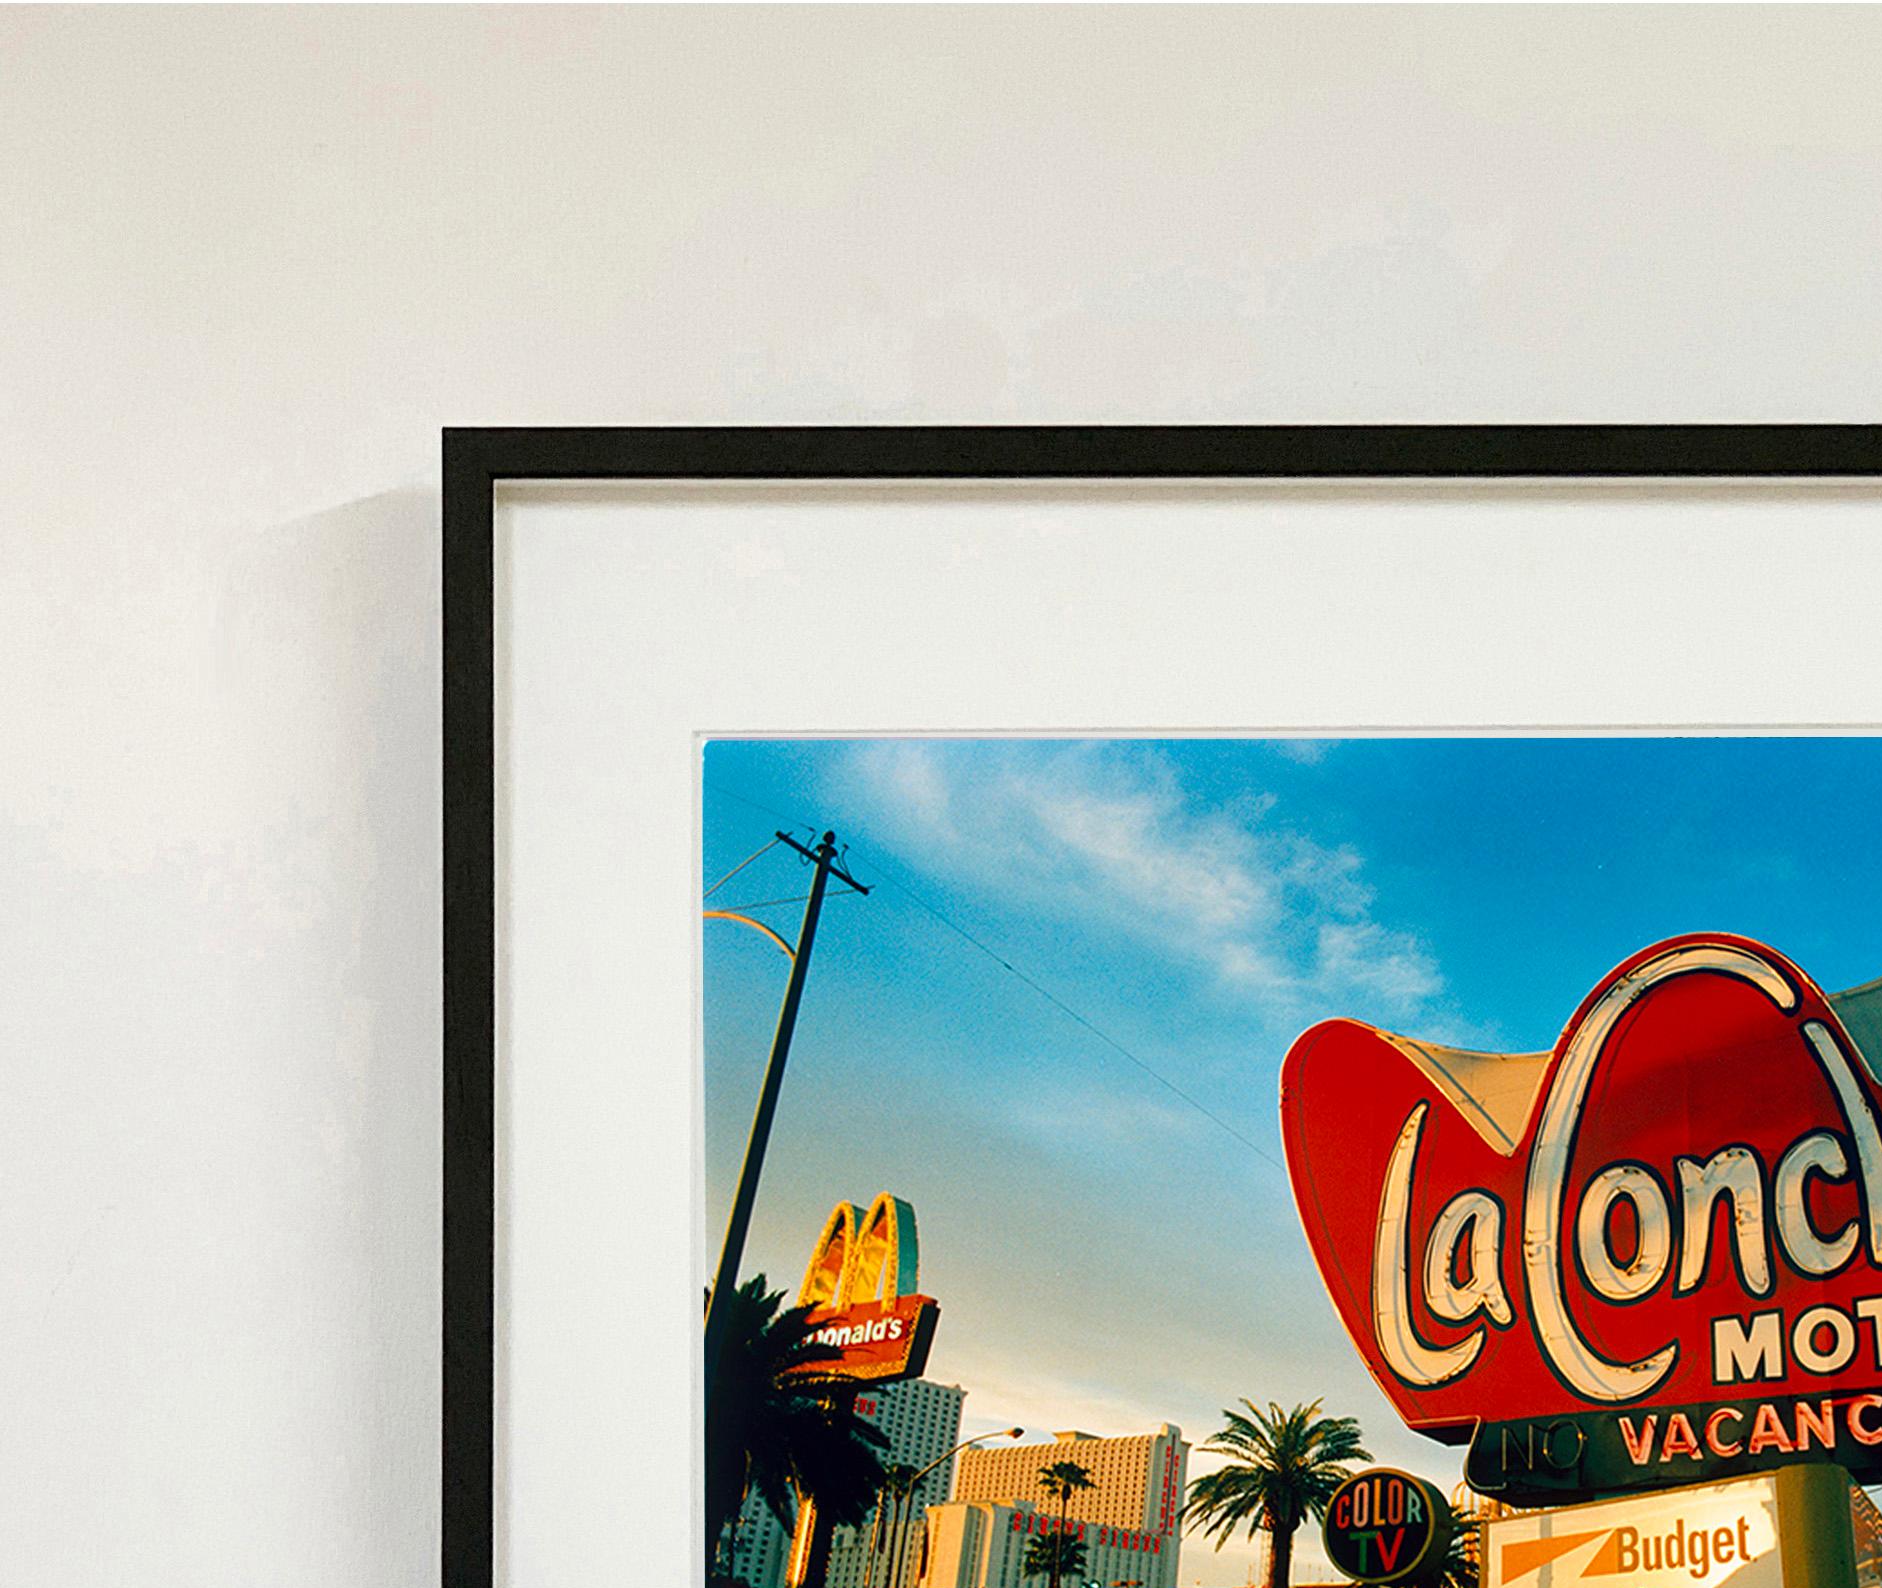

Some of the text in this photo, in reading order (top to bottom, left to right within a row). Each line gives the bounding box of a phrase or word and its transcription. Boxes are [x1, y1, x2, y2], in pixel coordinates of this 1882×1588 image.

[1373, 1101, 1514, 1388] La
[1500, 1420, 1586, 1472] NO
[1336, 1478, 1423, 1529] COLOR
[1349, 1527, 1406, 1574] TV
[1615, 1518, 1752, 1579] Budget
